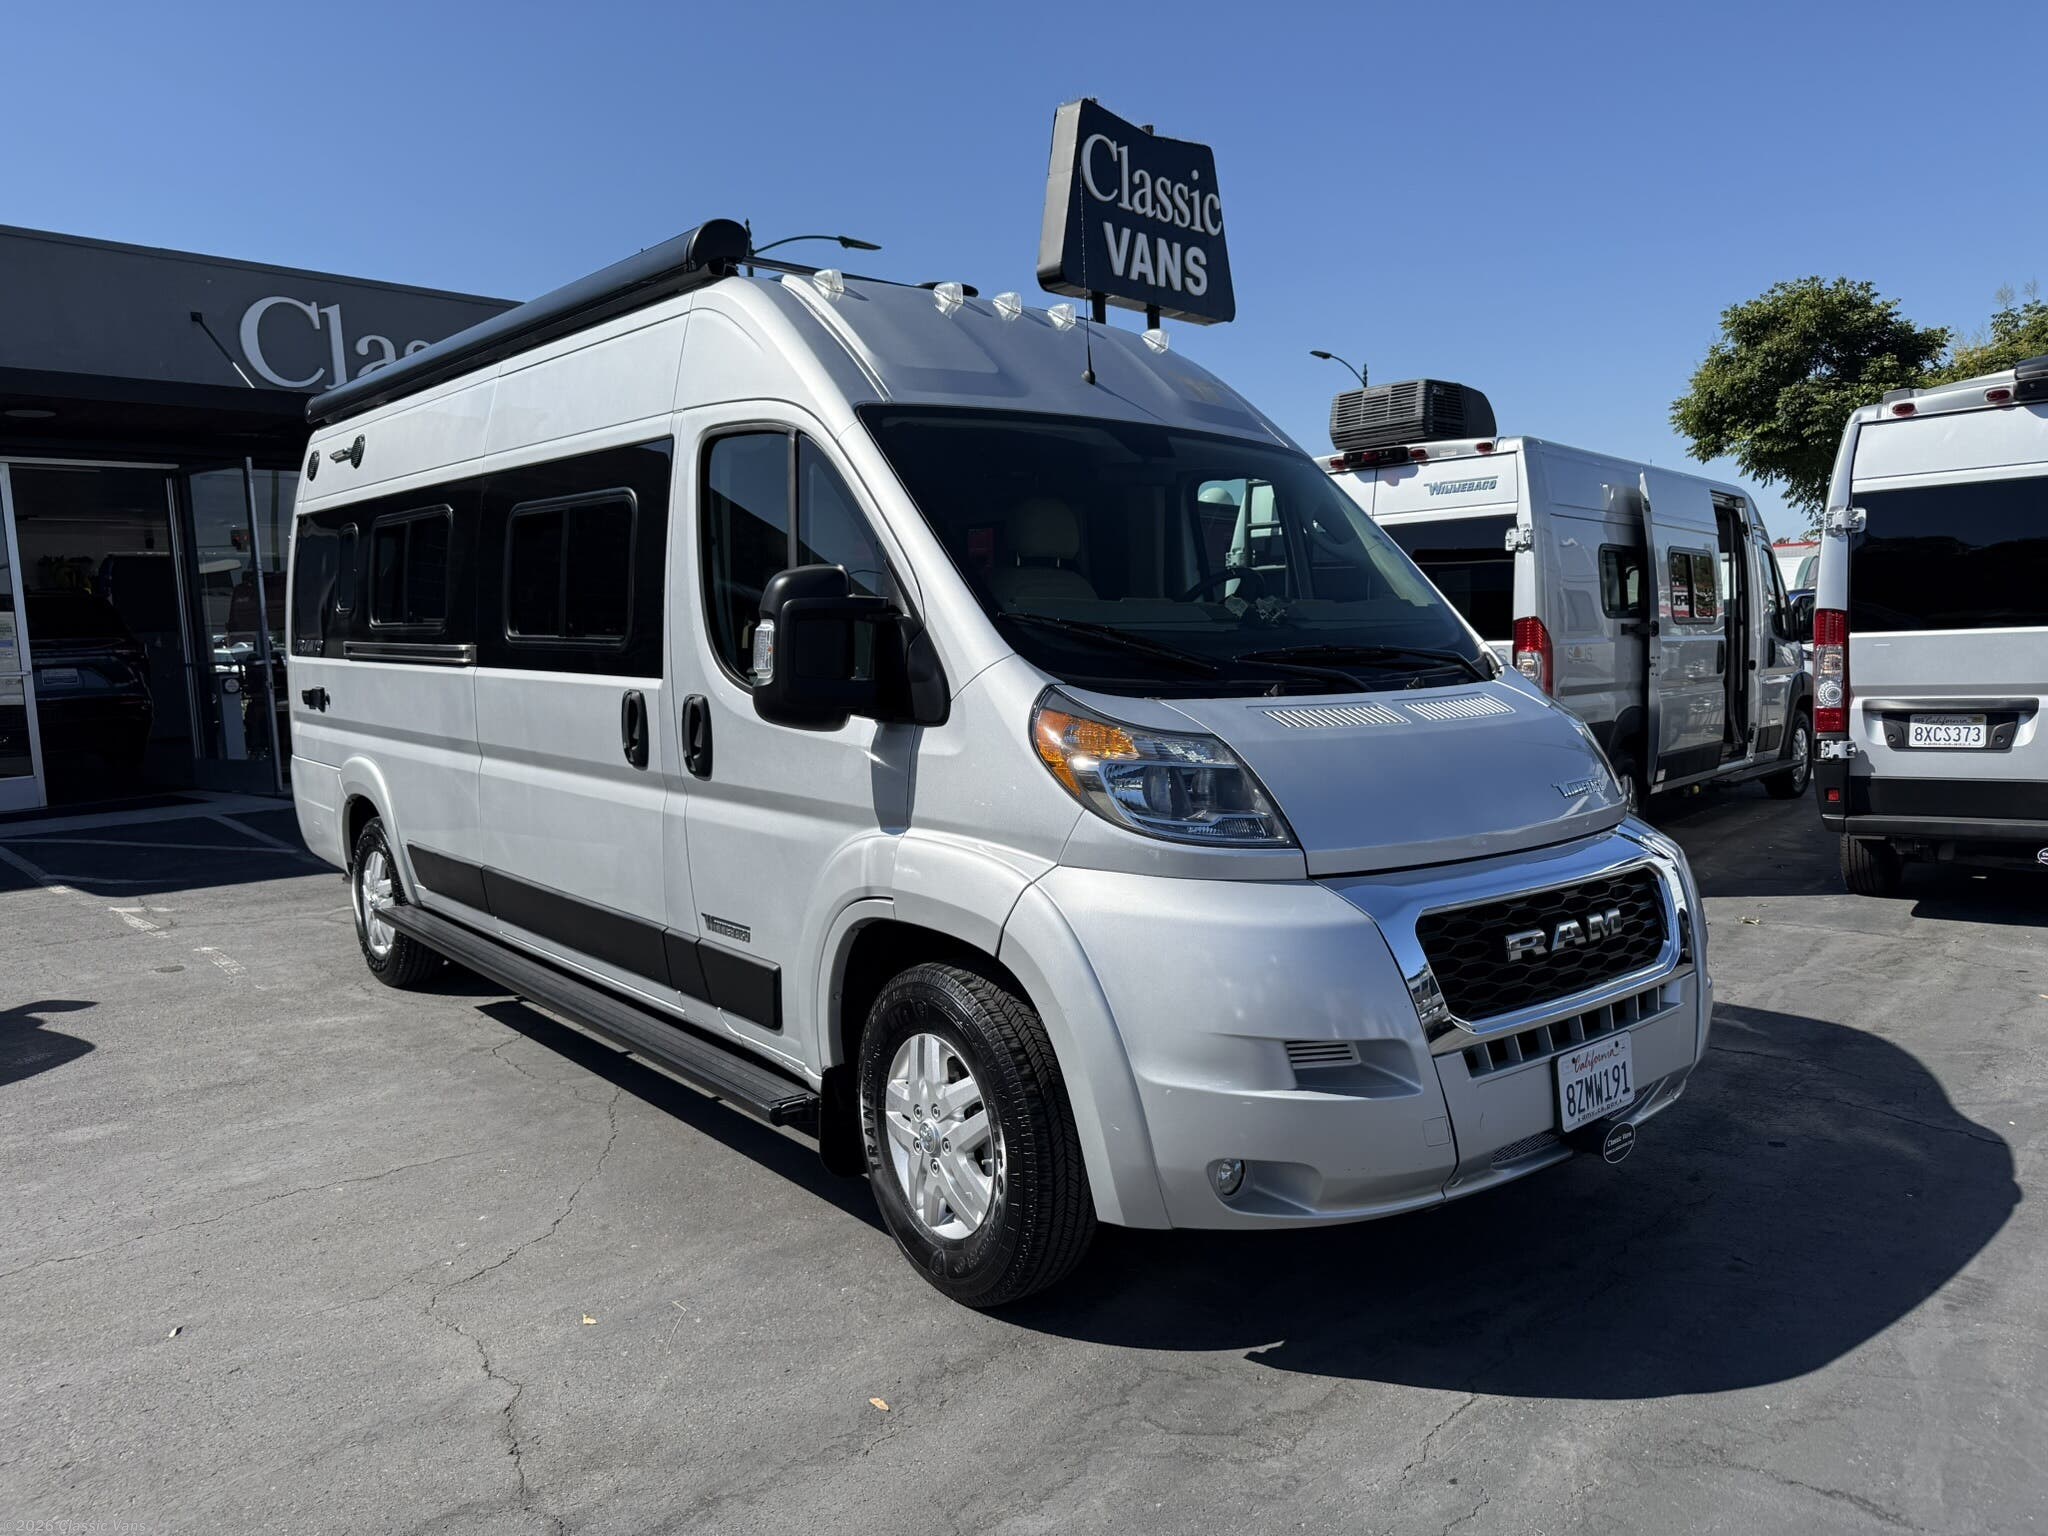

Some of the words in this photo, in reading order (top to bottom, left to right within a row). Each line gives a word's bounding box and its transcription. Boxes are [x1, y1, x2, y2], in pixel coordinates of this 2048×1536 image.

[1081, 133, 1222, 236] Classic
[1103, 221, 1208, 296] VANS
[1914, 727, 1981, 742] 8XCS373
[1504, 908, 1623, 962] RAM
[1574, 1048, 1620, 1073] California
[1566, 1061, 1631, 1117] 8ZMW191
